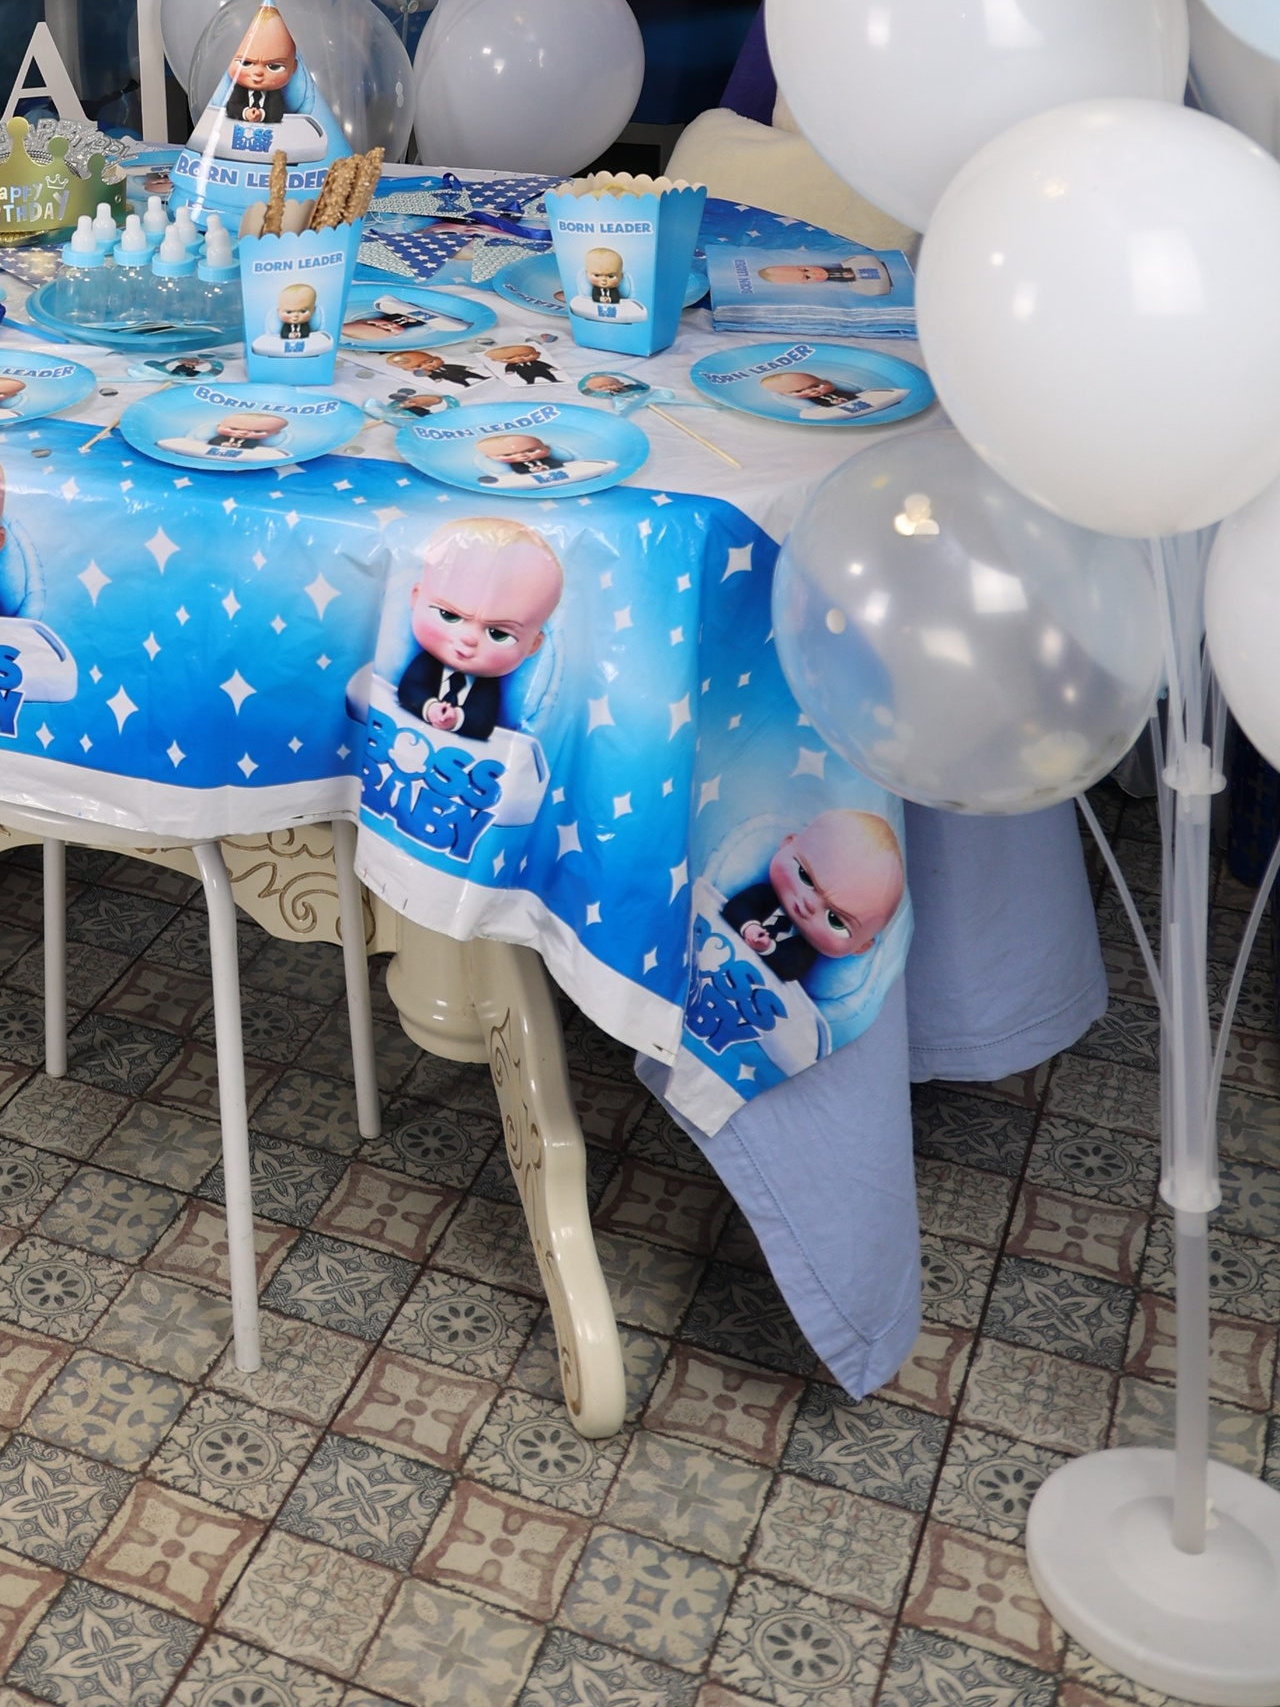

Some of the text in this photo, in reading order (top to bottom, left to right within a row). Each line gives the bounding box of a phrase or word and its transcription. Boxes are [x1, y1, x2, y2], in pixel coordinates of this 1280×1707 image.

[176, 154, 238, 186] BORN
[246, 170, 329, 189] LEDER
[558, 221, 653, 234] BORN LEADER
[253, 252, 343, 273] BORN LEADER
[2, 365, 75, 378] LEADER
[748, 343, 816, 375] LEADER
[195, 385, 340, 415] BORN LEADER
[413, 405, 561, 441] BORN LEADER
[365, 704, 507, 811] BOSS
[685, 983, 762, 1055] BY
